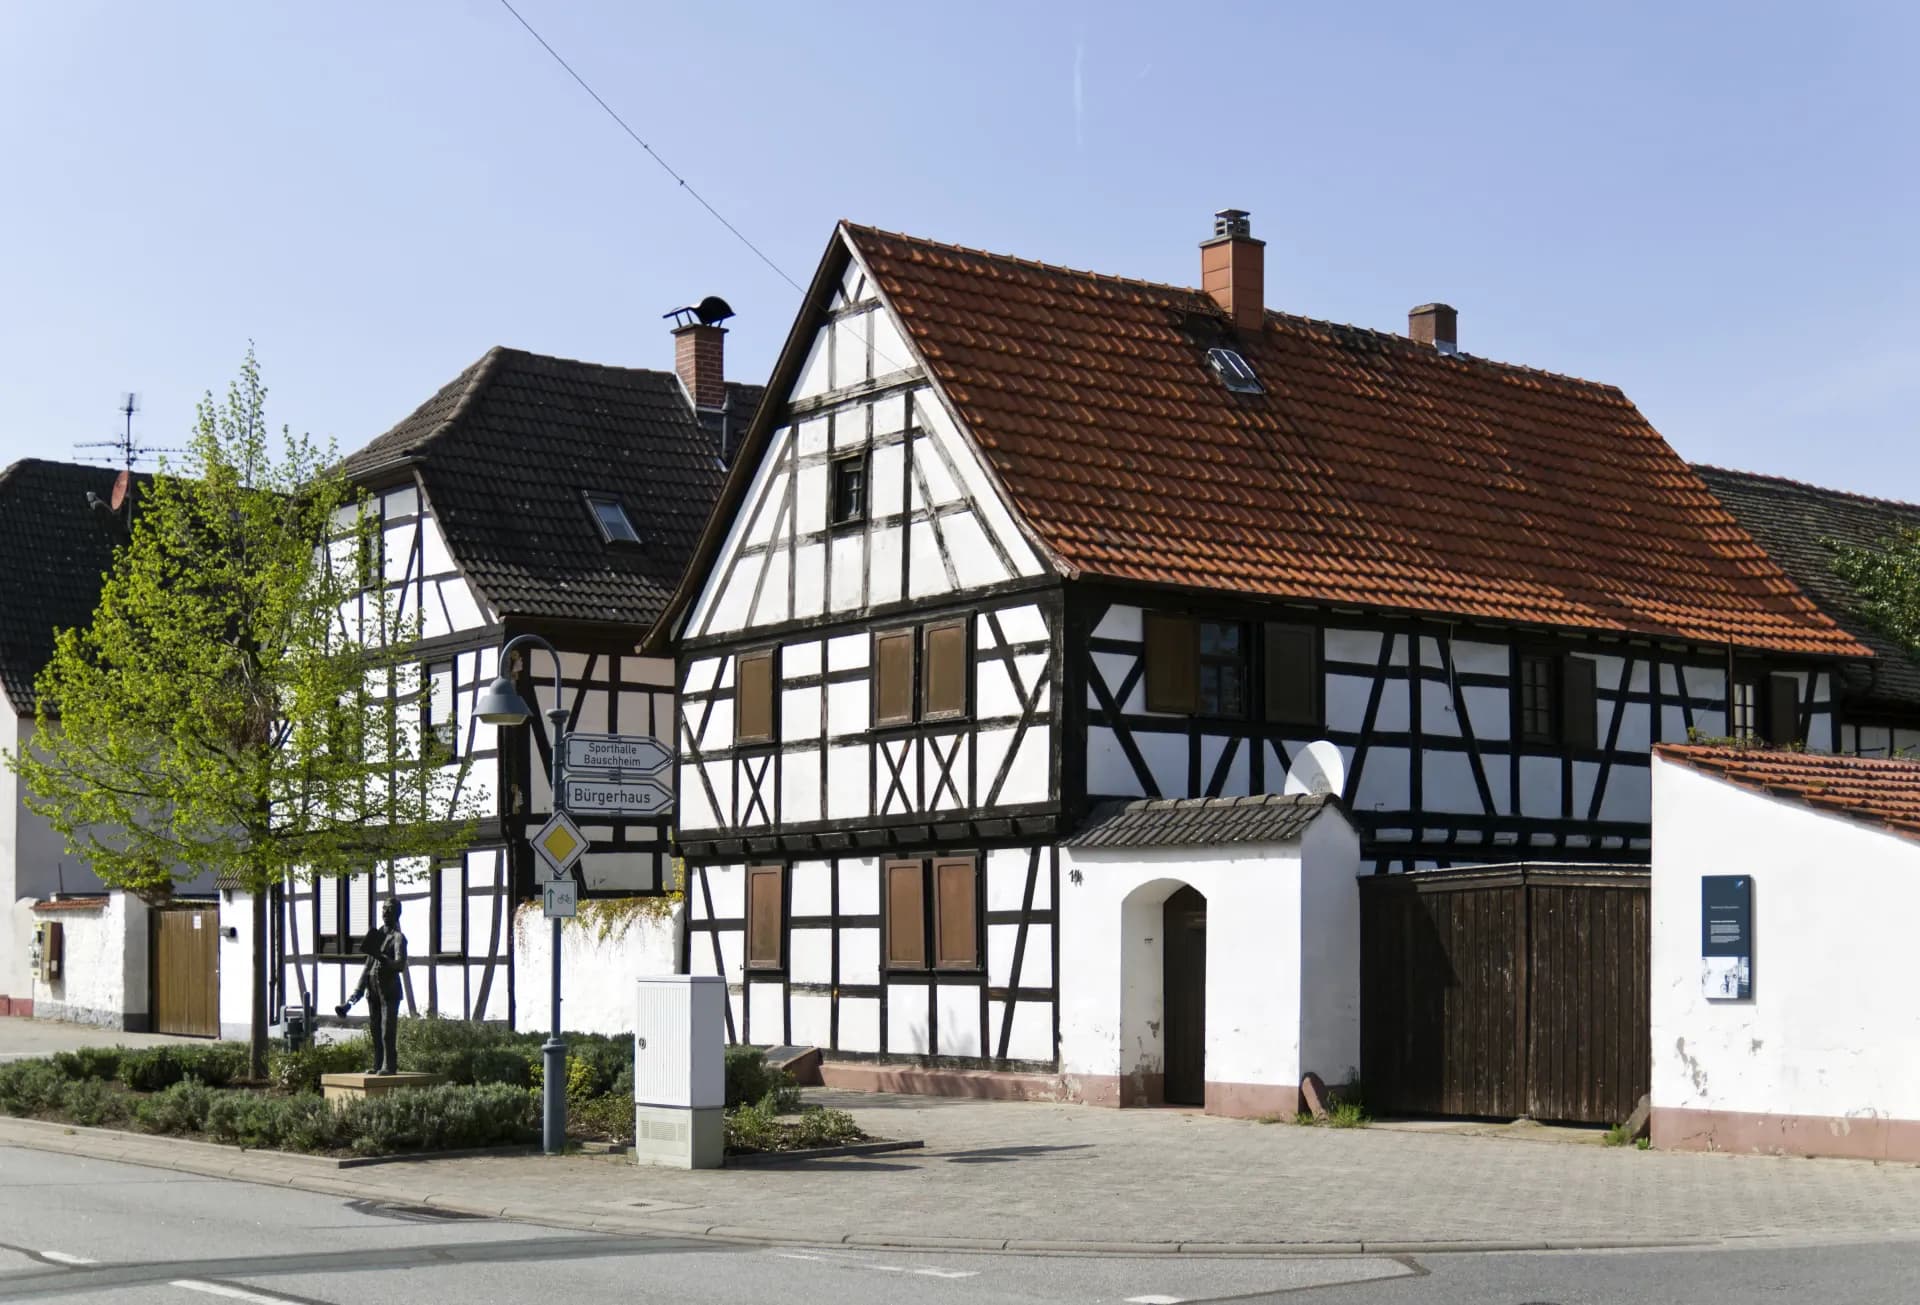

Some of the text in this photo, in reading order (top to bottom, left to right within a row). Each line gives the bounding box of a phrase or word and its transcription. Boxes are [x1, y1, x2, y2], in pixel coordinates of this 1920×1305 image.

[588, 742, 637, 754] Sporthalle
[583, 754, 641, 766] Bauschheim
[574, 788, 651, 805] Bürgerhaus
